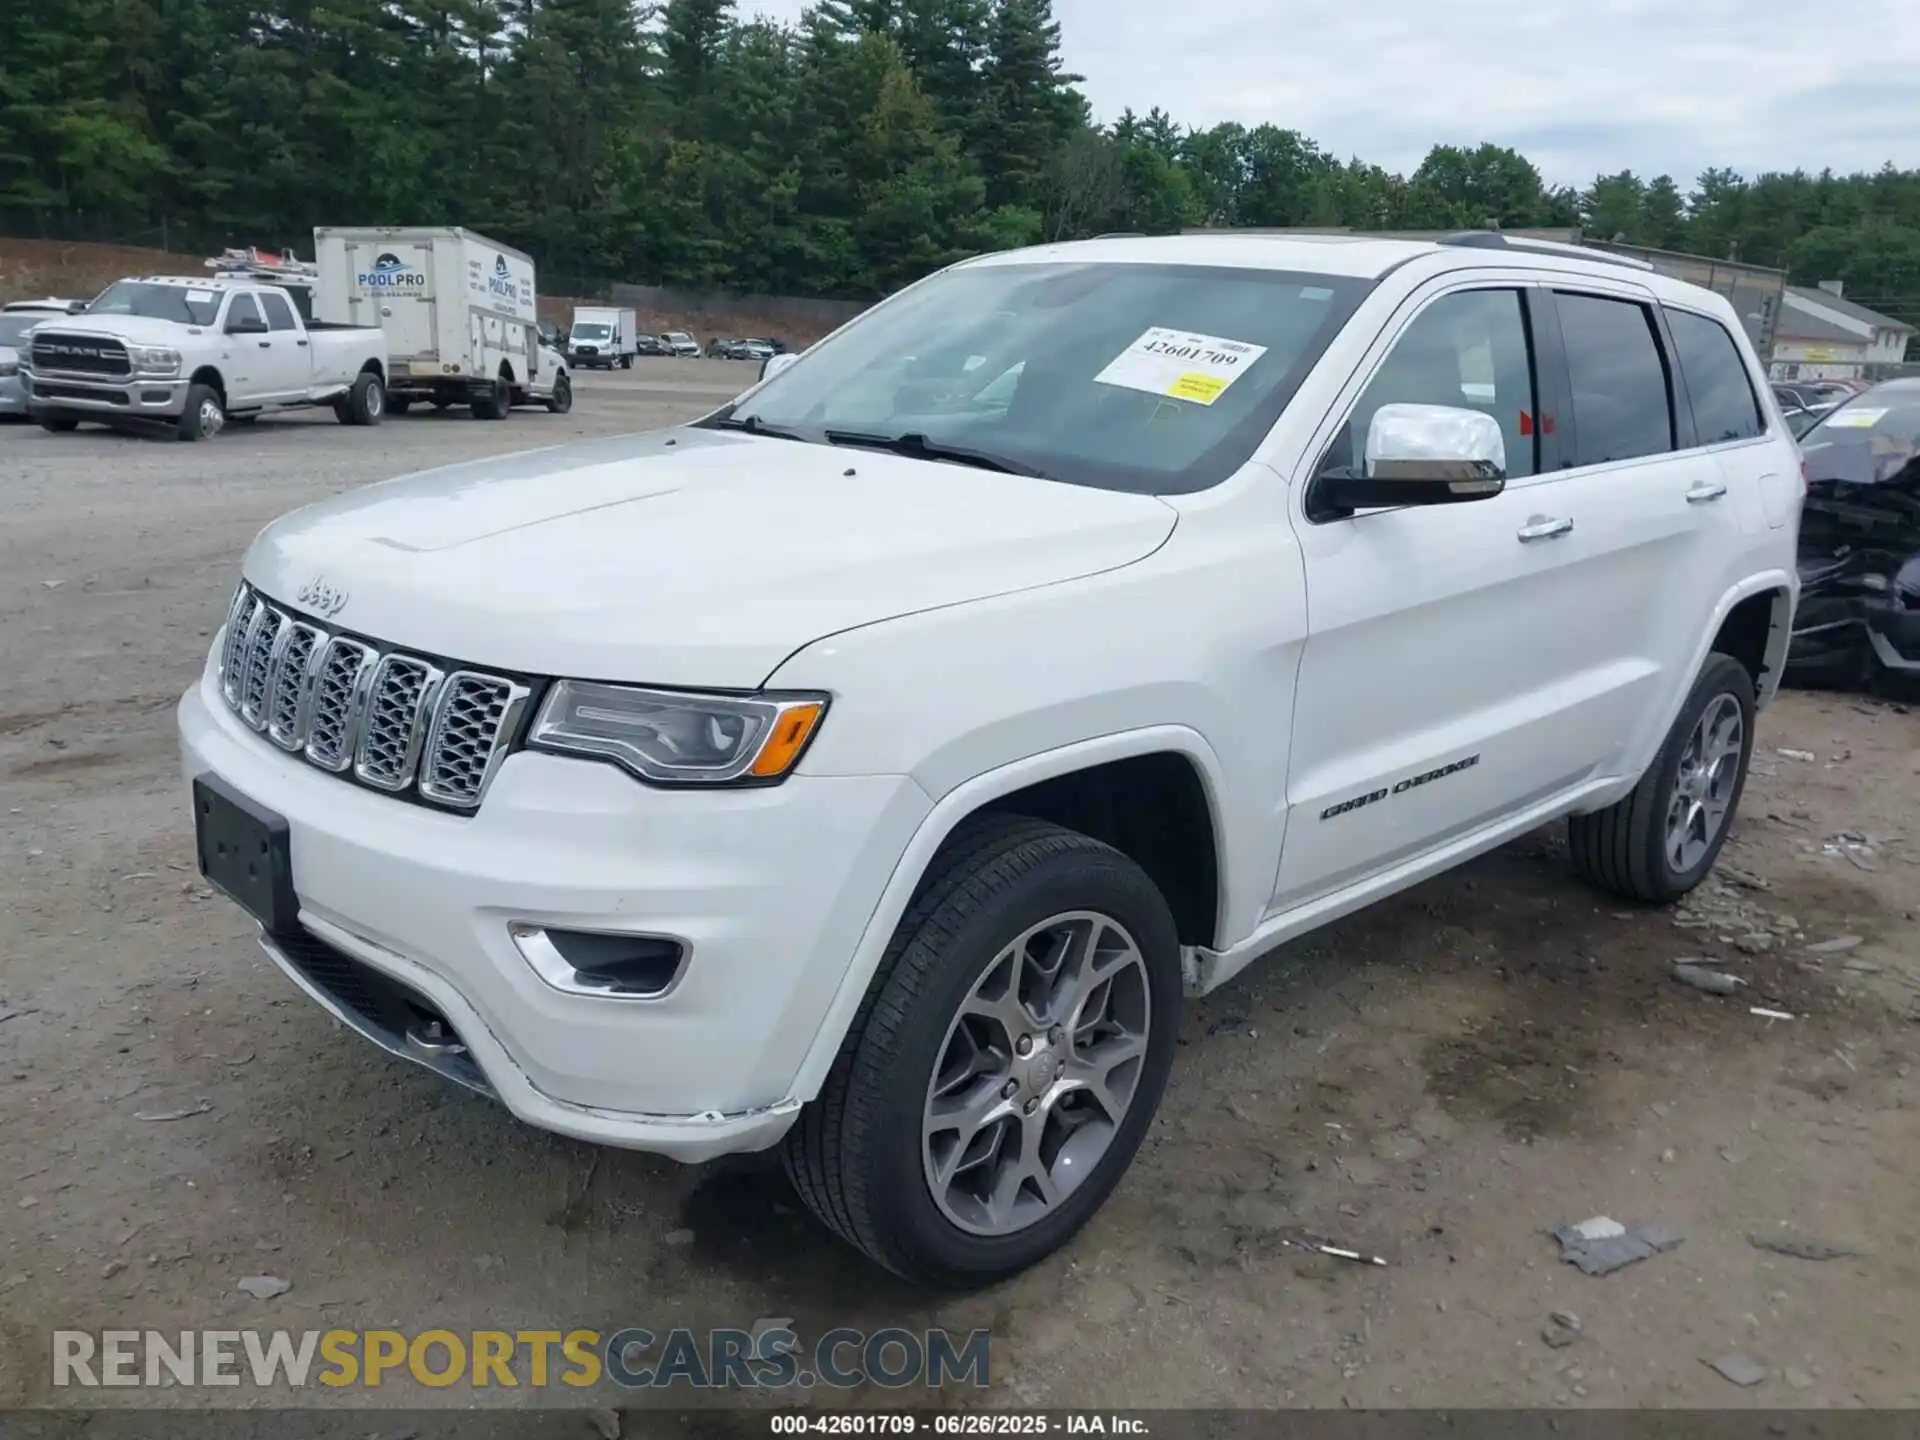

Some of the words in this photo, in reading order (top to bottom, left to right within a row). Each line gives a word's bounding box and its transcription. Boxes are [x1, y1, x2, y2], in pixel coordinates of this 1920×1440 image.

[358, 273, 425, 286] POOLPRO
[488, 276, 517, 299] POOLPRO
[1143, 340, 1239, 365] 42601709
[297, 575, 349, 618] Jeep
[1320, 787, 1388, 821] GRAND
[1391, 753, 1480, 794] CHEROKEE
